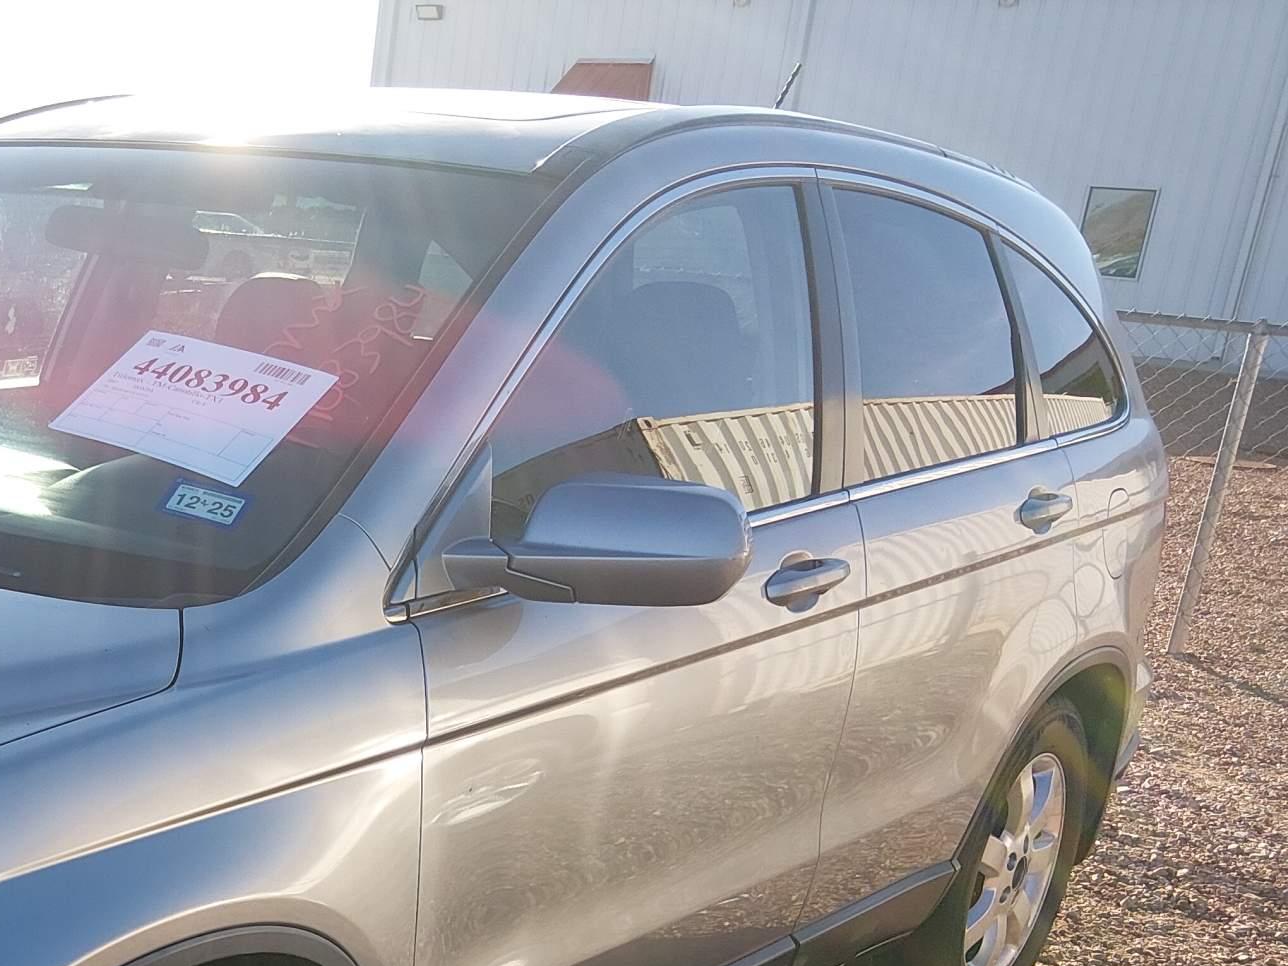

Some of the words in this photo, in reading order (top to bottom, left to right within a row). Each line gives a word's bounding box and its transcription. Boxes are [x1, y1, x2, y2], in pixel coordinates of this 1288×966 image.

[133, 357, 289, 411] 44083984
[176, 493, 201, 509] 12
[206, 501, 237, 518] 25
